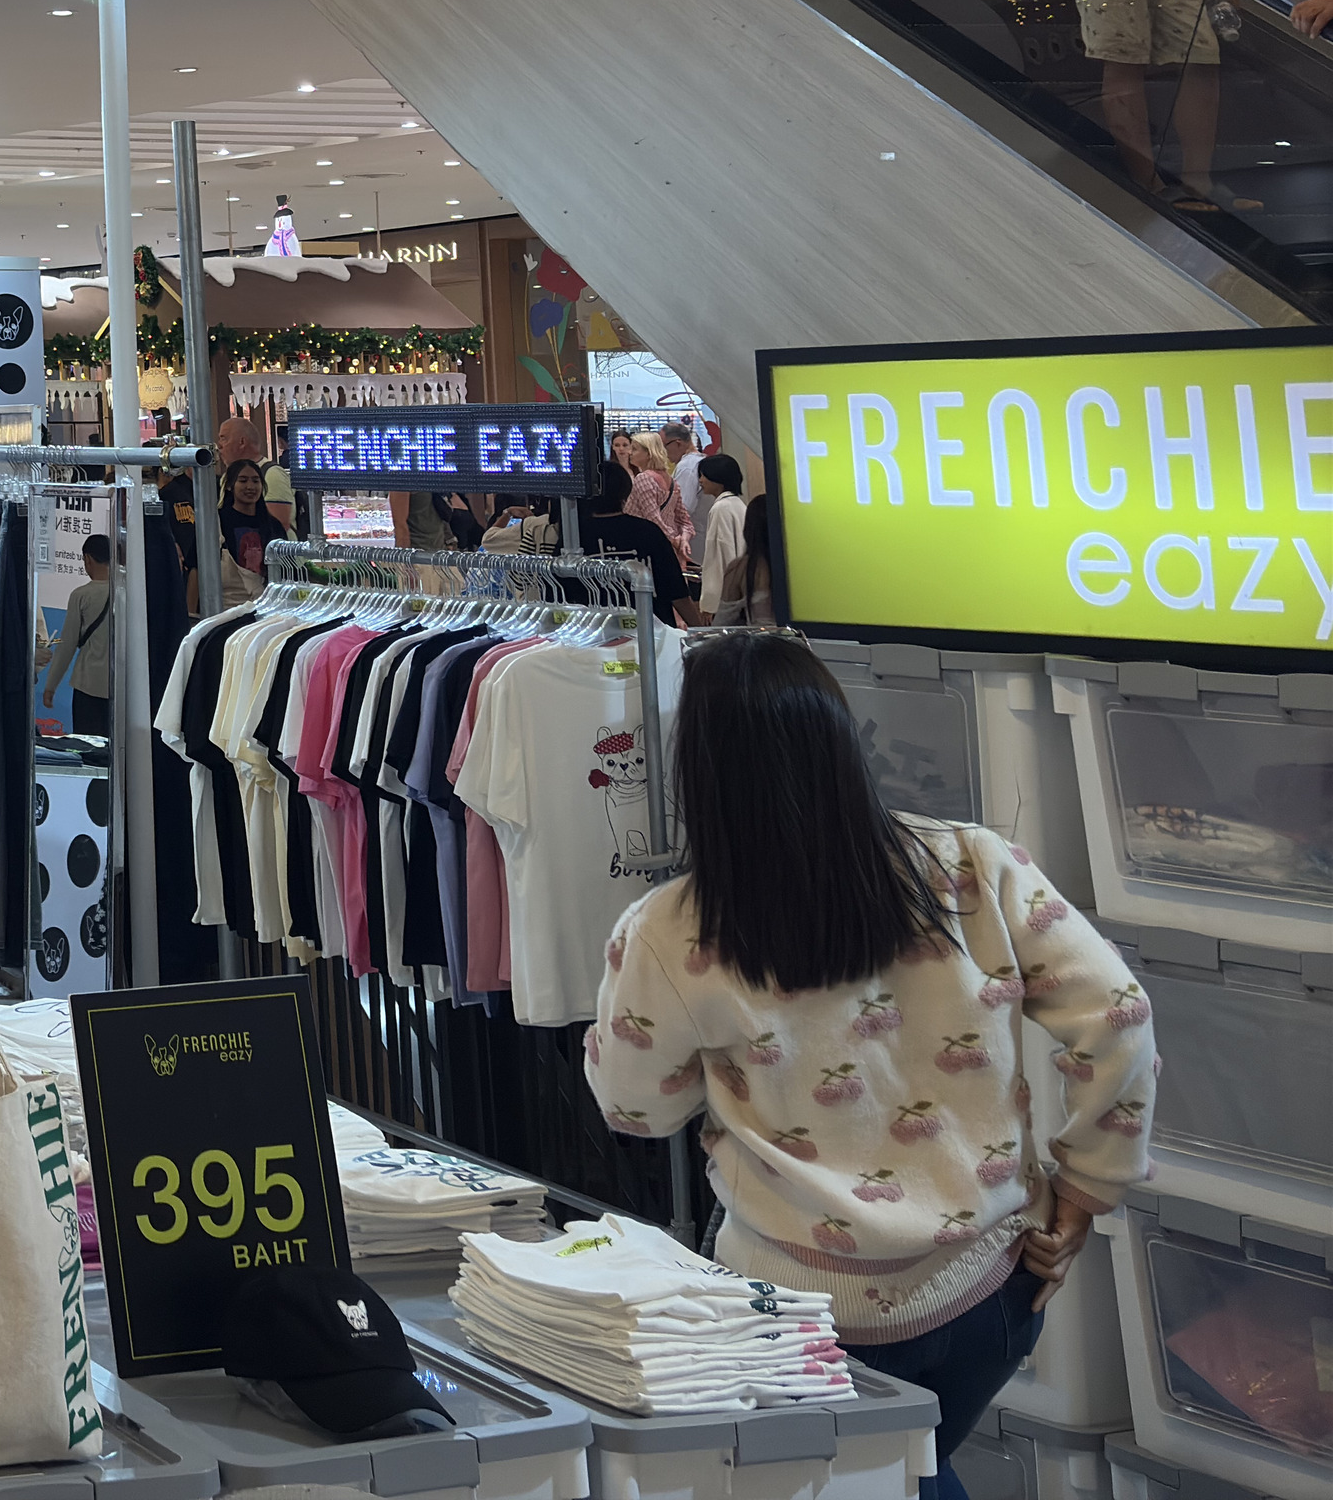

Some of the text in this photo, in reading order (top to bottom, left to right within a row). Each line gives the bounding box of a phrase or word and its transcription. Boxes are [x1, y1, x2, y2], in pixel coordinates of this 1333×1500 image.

[590, 370, 630, 380] HARNN
[296, 425, 581, 473] FRENCHIE EAZY
[789, 382, 1333, 511] FRENCHIE
[1066, 531, 1333, 641] eazy
[183, 1031, 252, 1053] FRENCHIE
[219, 1048, 253, 1063] eazy
[132, 1143, 305, 1245] 395
[232, 1238, 308, 1269] BAHT
